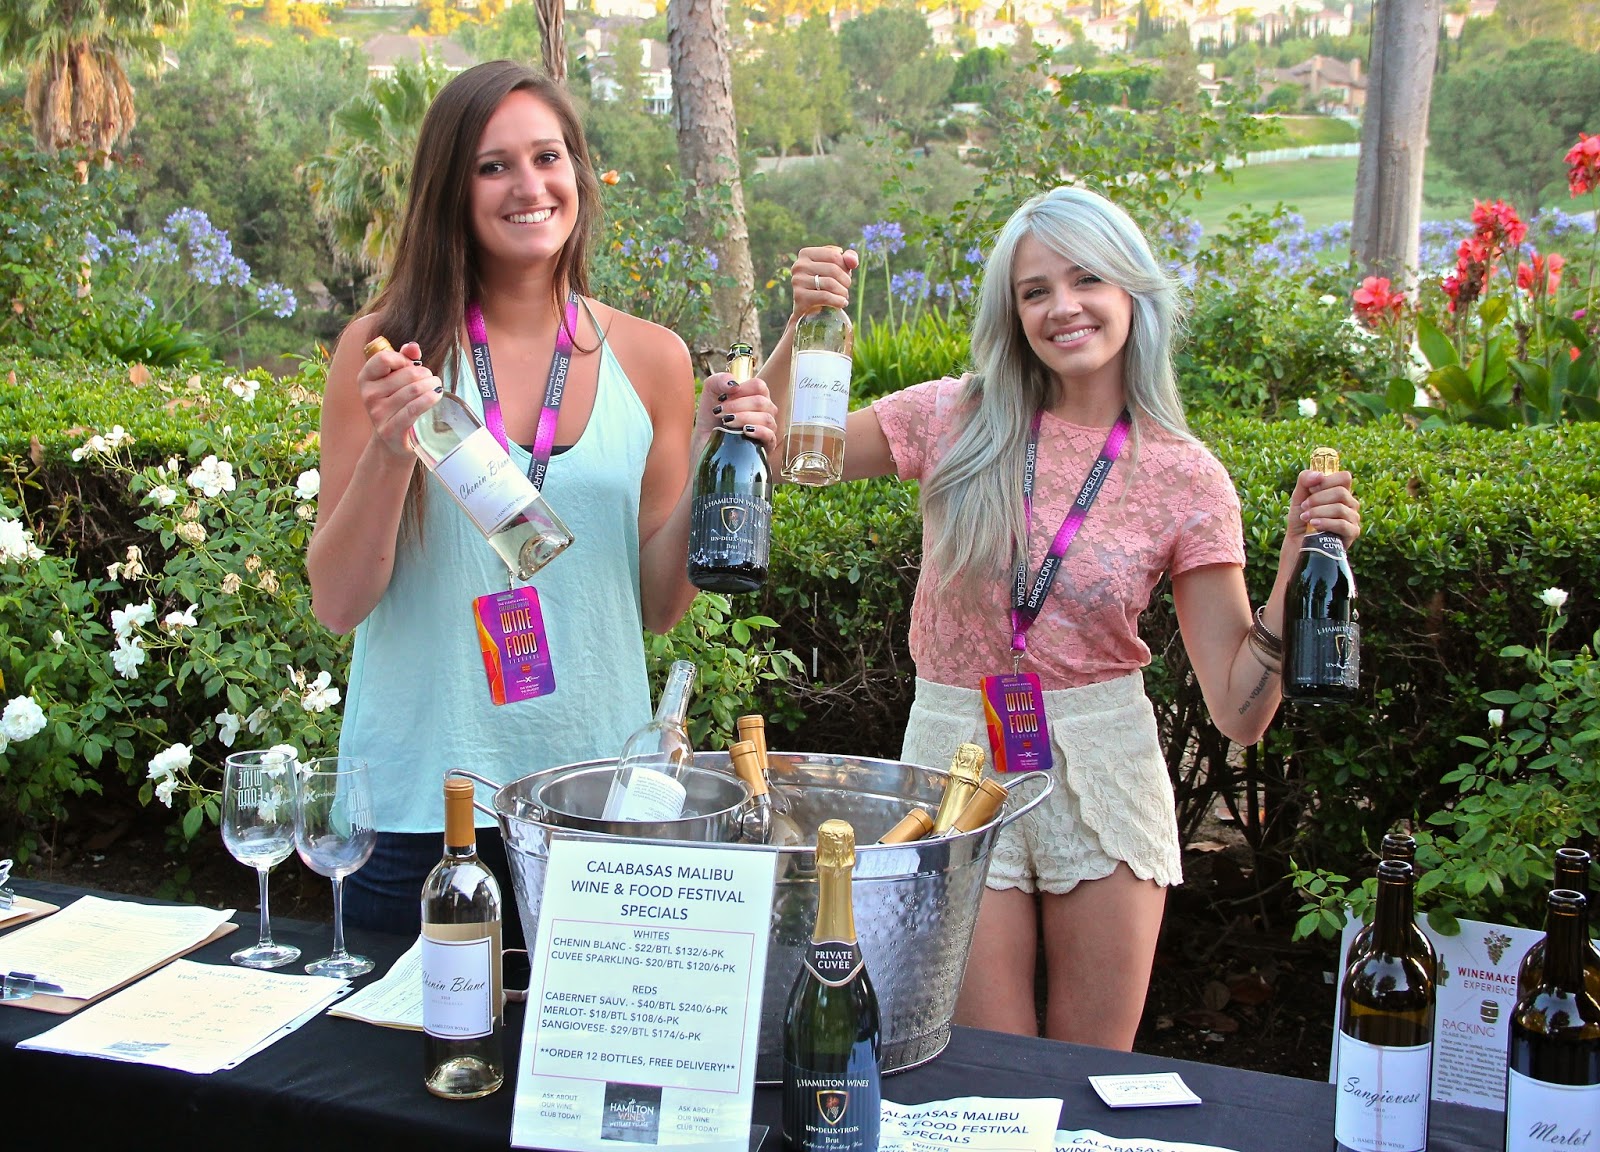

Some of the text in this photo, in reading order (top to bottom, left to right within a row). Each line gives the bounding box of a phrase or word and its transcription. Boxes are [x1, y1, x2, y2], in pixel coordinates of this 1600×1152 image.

[474, 347, 491, 398] BARCELONA
[550, 356, 568, 406] BARCELONA
[798, 376, 848, 395] Chenin Blan
[1024, 443, 1036, 492] BARCELONA
[460, 475, 486, 500] Chenin
[1076, 460, 1106, 506] BARCELONA
[1018, 560, 1026, 606] RCELONA
[1028, 558, 1054, 608] BARCELONA
[500, 608, 533, 634] WINE
[505, 632, 538, 658] FOOD
[1005, 692, 1035, 712] WINE
[1009, 714, 1038, 734] FOOD
[587, 860, 734, 882] CALABASAS MALIBU
[572, 880, 745, 903] WINE & FOOD FESTIVAL
[620, 904, 688, 920] SPECIALS
[634, 930, 670, 940] WHITES
[554, 938, 590, 948] CHENIN
[594, 940, 626, 950] BLANC
[634, 944, 672, 954] $22/BTL
[676, 946, 724, 958] $132/6-PK
[816, 950, 852, 960] PRIVATE
[552, 951, 736, 973] CUVEE SPARKLING- $20/BTL $120/6-PK
[818, 958, 850, 969] CUVÉE
[450, 976, 486, 992] Blanc
[1458, 966, 1516, 984] WINEMAKE
[632, 985, 658, 994] REDS
[1464, 980, 1515, 996] EXPERIENC
[546, 992, 597, 1004] CABERNET
[600, 996, 628, 1006] SAUV.
[637, 1000, 676, 1010] $40/BTL
[678, 1002, 728, 1015] $240/6-PK
[544, 1006, 679, 1025] MERLOT- $18/BTL $108/6-PK
[542, 1019, 702, 1040] SANGIOVESE- $29/BTL $174/6-PK
[1442, 1018, 1496, 1038] RACKING
[586, 1052, 598, 1060] 12
[600, 1053, 646, 1066] BOTTLES,
[649, 1058, 673, 1068] FREE
[1344, 1076, 1420, 1108] Sangiovese
[540, 1110, 556, 1118] CLUB
[556, 1102, 572, 1110] WINE
[610, 1103, 654, 1115] HAMILTON
[692, 1106, 715, 1114] ABOUT
[880, 1108, 958, 1120] ALABASAS
[962, 1112, 1020, 1121] MALIBU
[618, 1112, 646, 1122] WINES
[913, 1120, 957, 1130] FOOD
[962, 1126, 1030, 1134] FESTIVAL
[1528, 1122, 1592, 1146] Merlot
[825, 1136, 840, 1144] Brut
[902, 1130, 970, 1144] SPECIALS
[912, 1142, 949, 1152] WHITES
